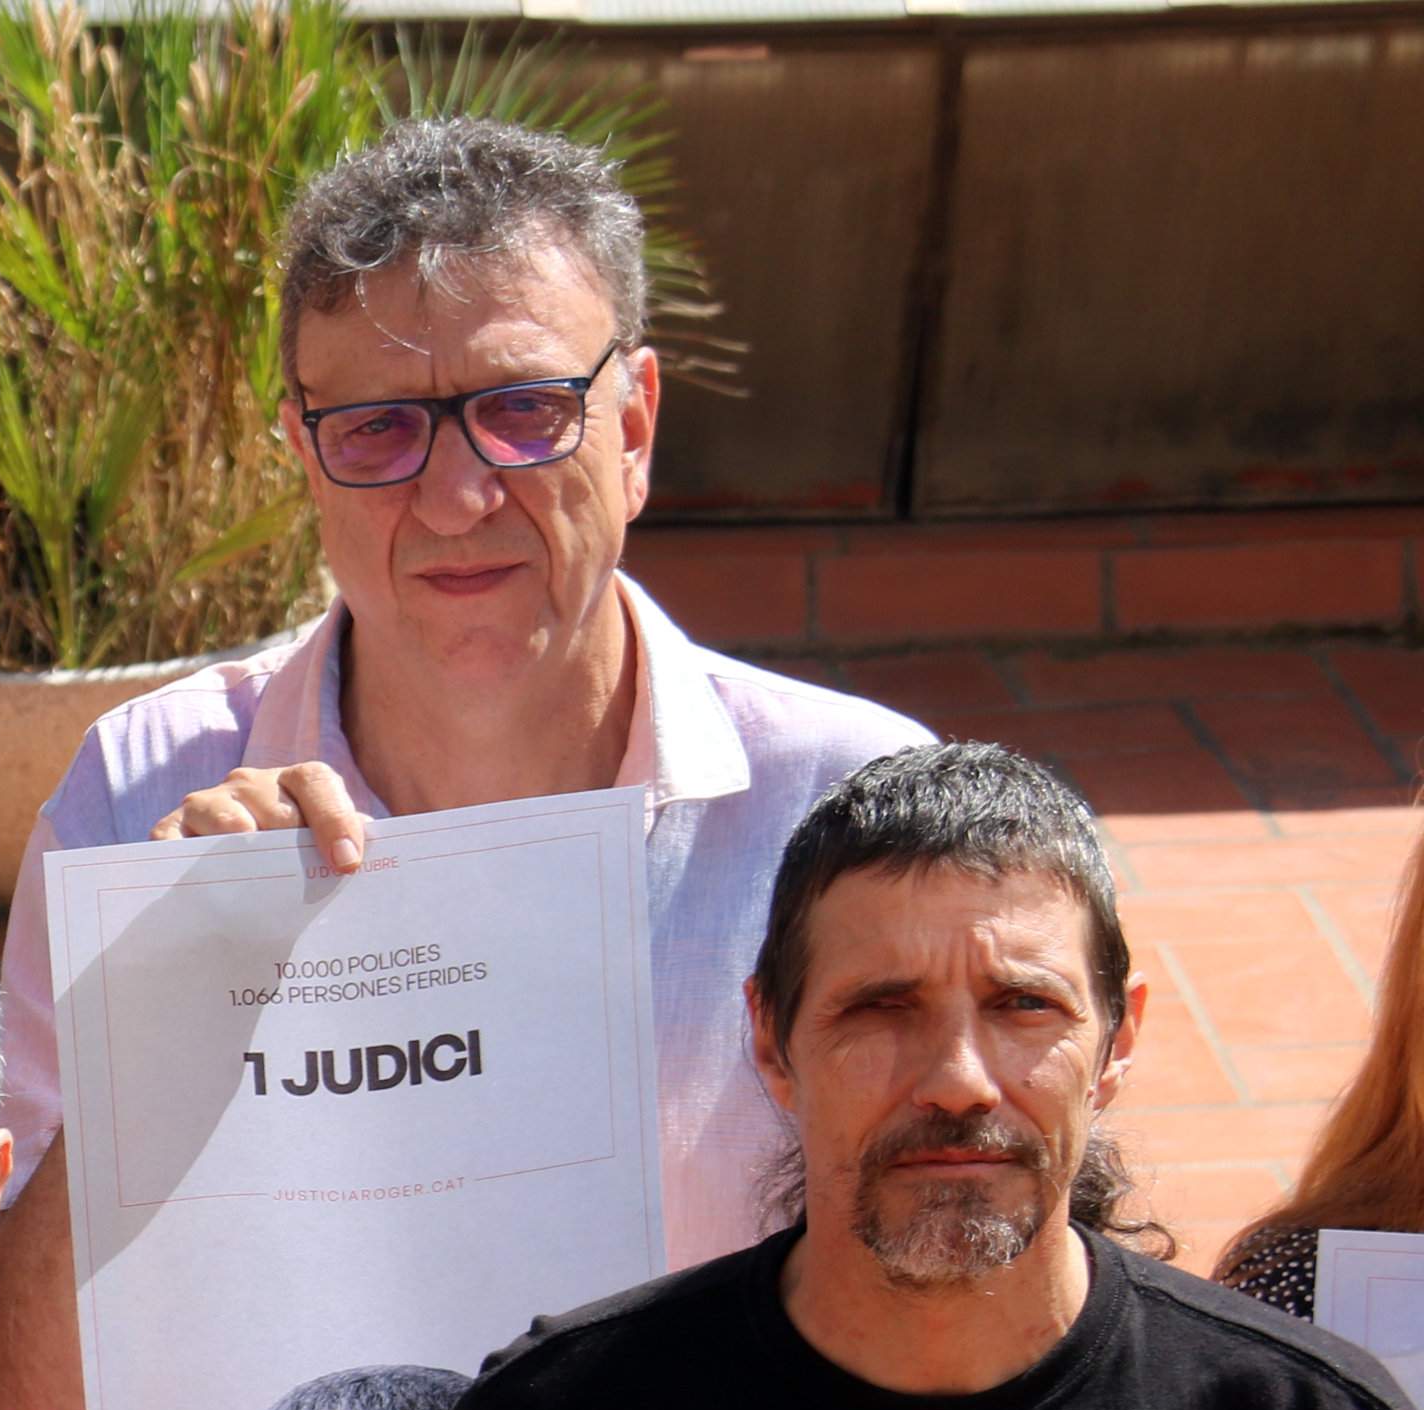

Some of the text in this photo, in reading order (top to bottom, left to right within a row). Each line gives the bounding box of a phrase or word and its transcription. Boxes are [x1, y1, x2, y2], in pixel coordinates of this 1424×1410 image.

[306, 867, 317, 879] U
[274, 944, 440, 979] 10.000 POLICIES
[229, 962, 487, 1006] 1.066 PERSONES FERIDES
[243, 1029, 482, 1096] 1 JUDICI
[273, 1177, 465, 1202] JUSTICIAROGER.CAT
